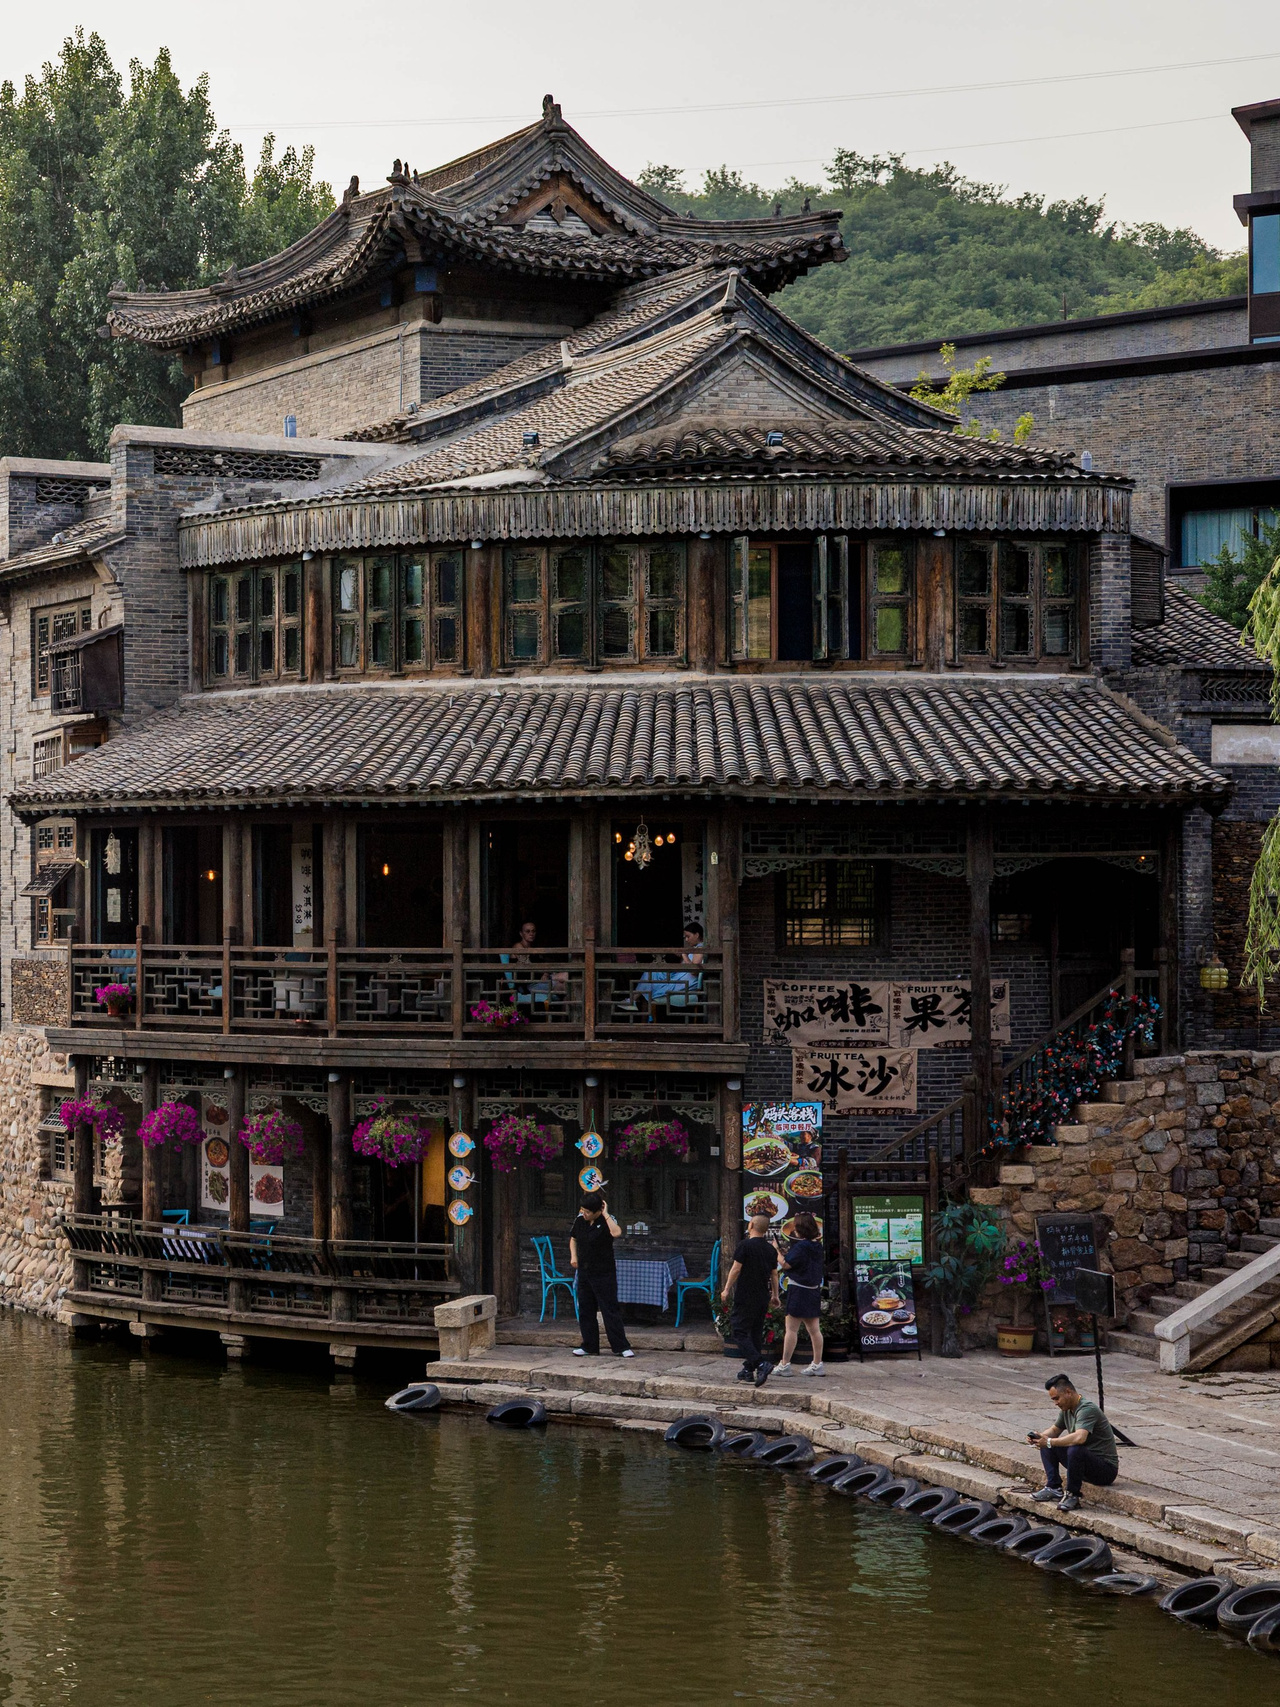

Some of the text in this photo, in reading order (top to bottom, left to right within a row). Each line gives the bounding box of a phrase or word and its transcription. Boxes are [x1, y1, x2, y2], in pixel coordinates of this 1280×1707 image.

[781, 984, 836, 993] COFFEE
[907, 985, 961, 994] FRUIT TEA
[772, 983, 884, 1032] 咖啡
[810, 1052, 842, 1060] FRUIT
[807, 1055, 899, 1098] 冰沙
[760, 1106, 817, 1124] 码头客栈
